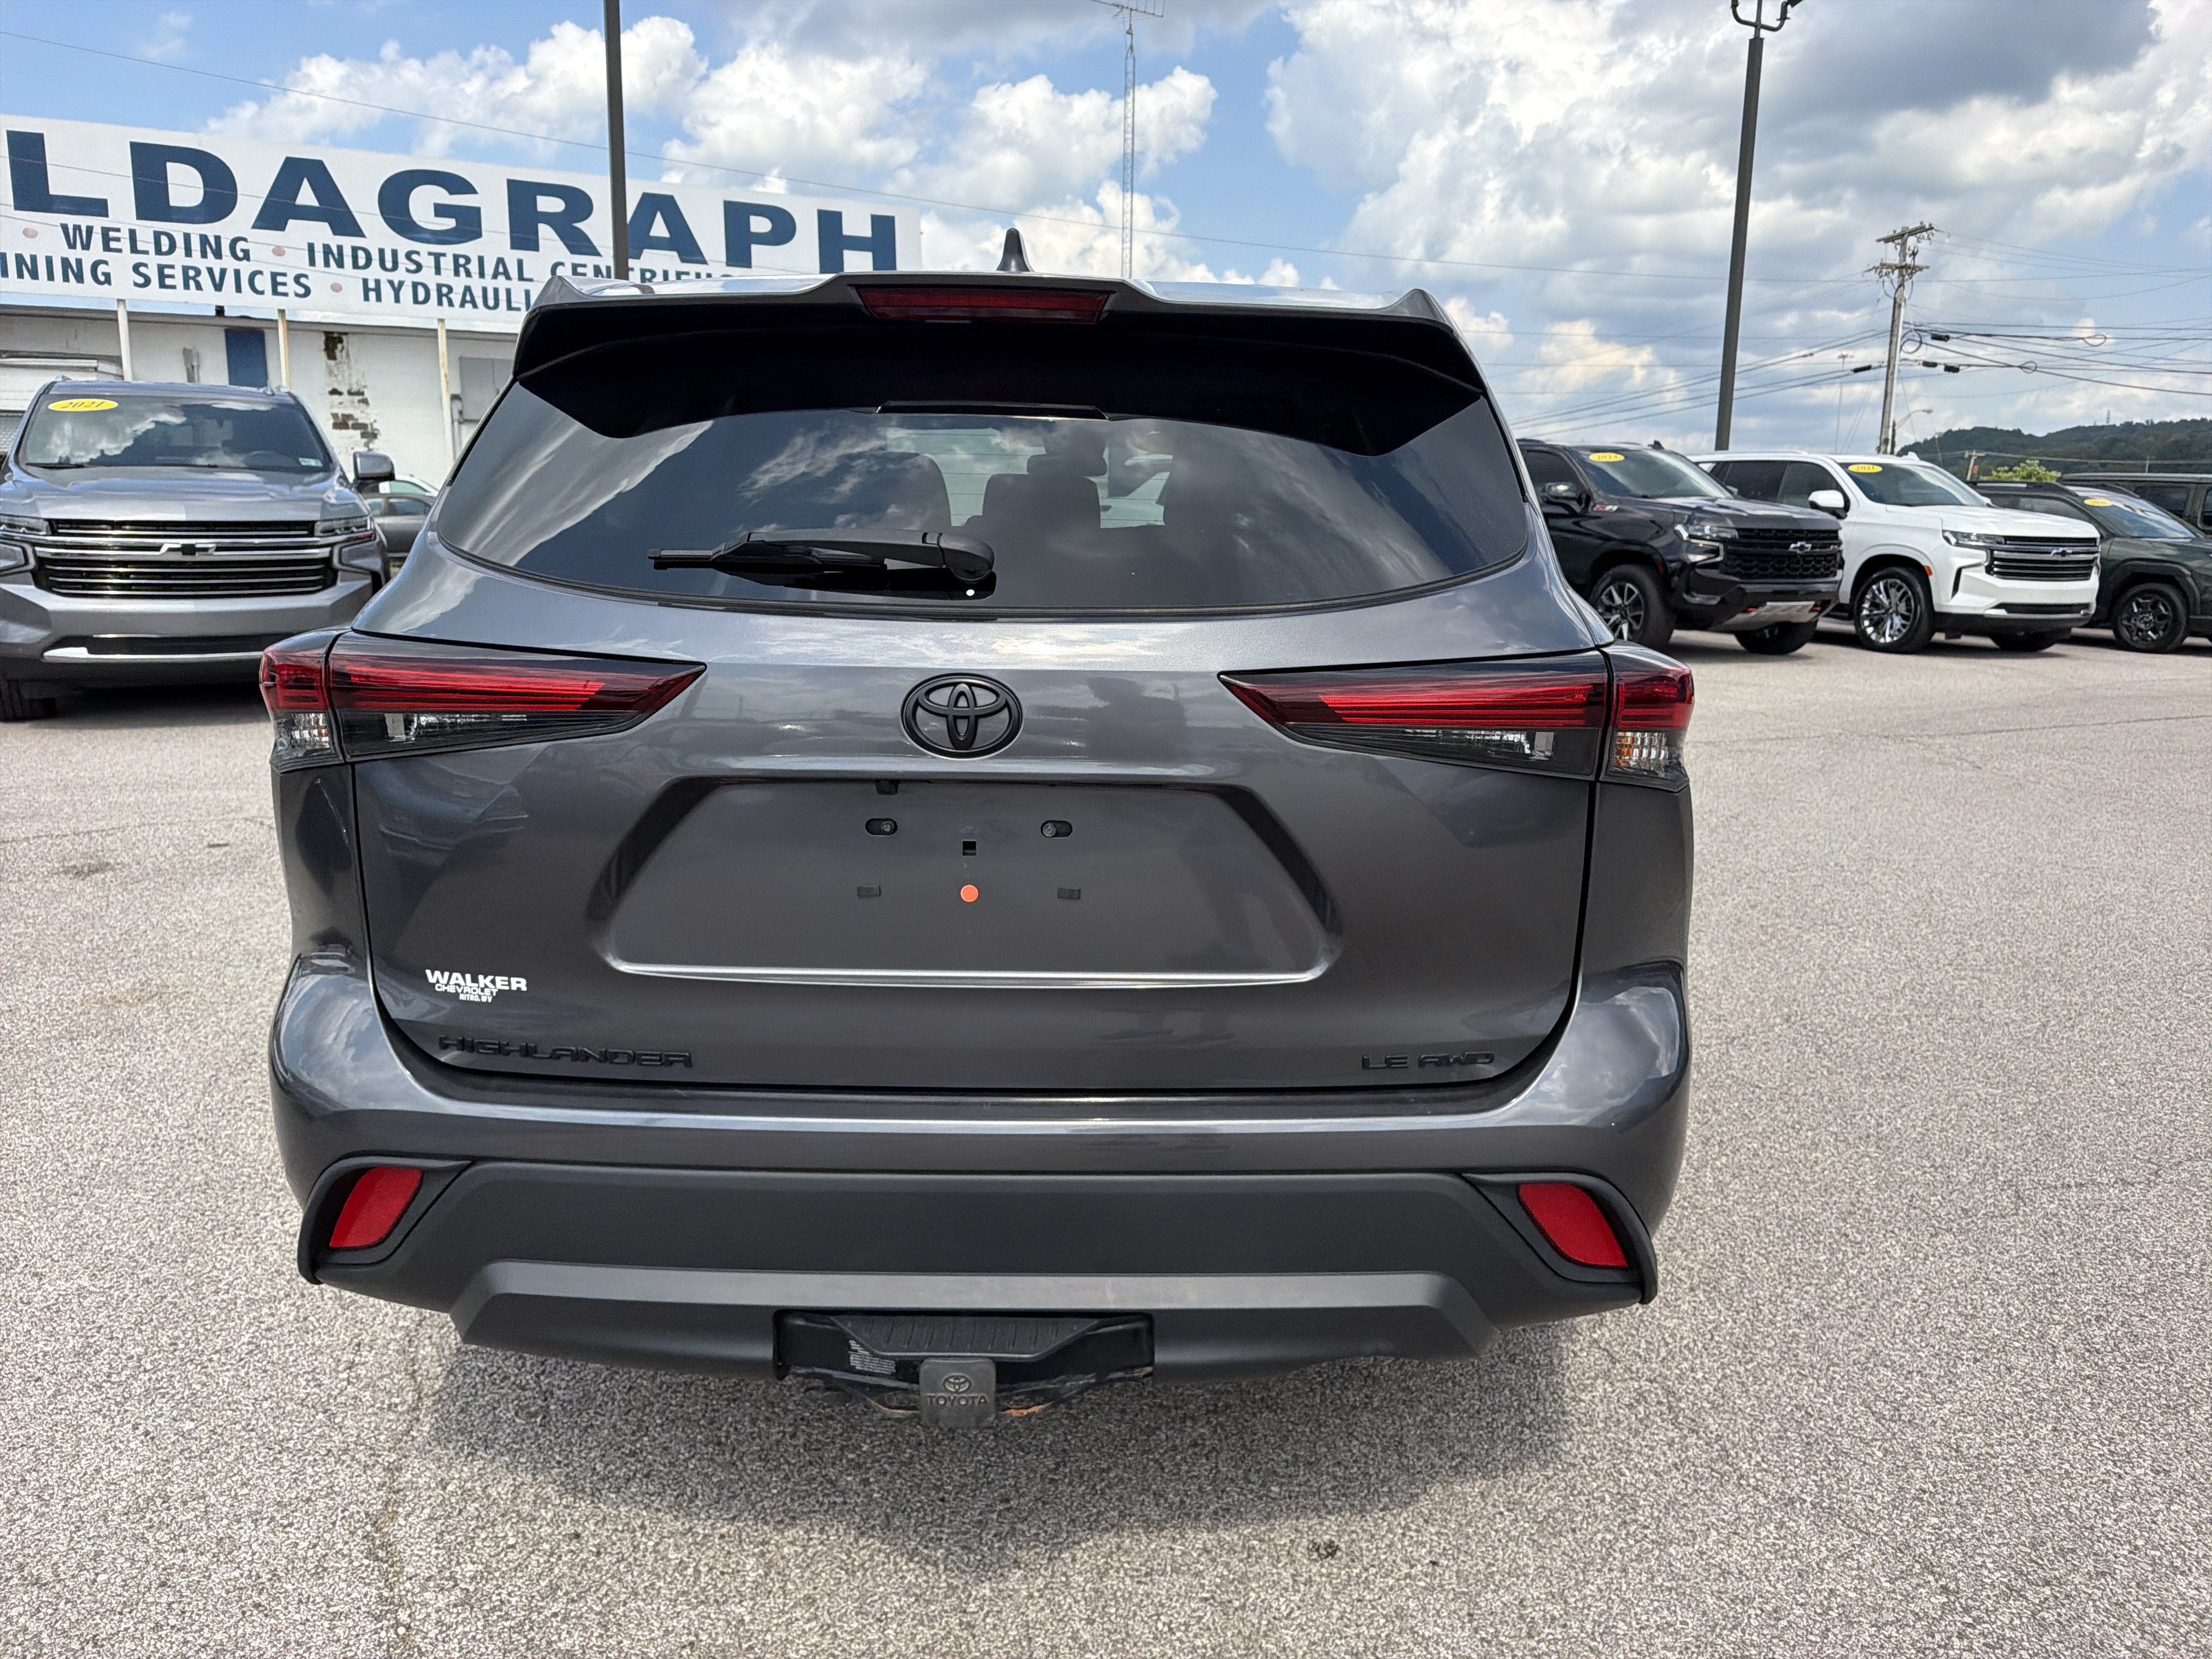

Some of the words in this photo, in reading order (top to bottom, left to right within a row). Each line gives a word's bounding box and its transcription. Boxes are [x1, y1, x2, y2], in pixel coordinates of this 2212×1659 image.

[60, 223, 251, 262] WELDING
[307, 242, 534, 282] INDUSTRIAL
[132, 261, 311, 298] SERVICES
[425, 969, 527, 991] WALKER
[435, 983, 498, 996] CHEVROLET
[439, 1035, 693, 1068] HIGHLANDER
[1362, 1054, 1408, 1070] LE
[1418, 1052, 1495, 1067] AWD
[926, 1393, 988, 1406] TOYOTA
